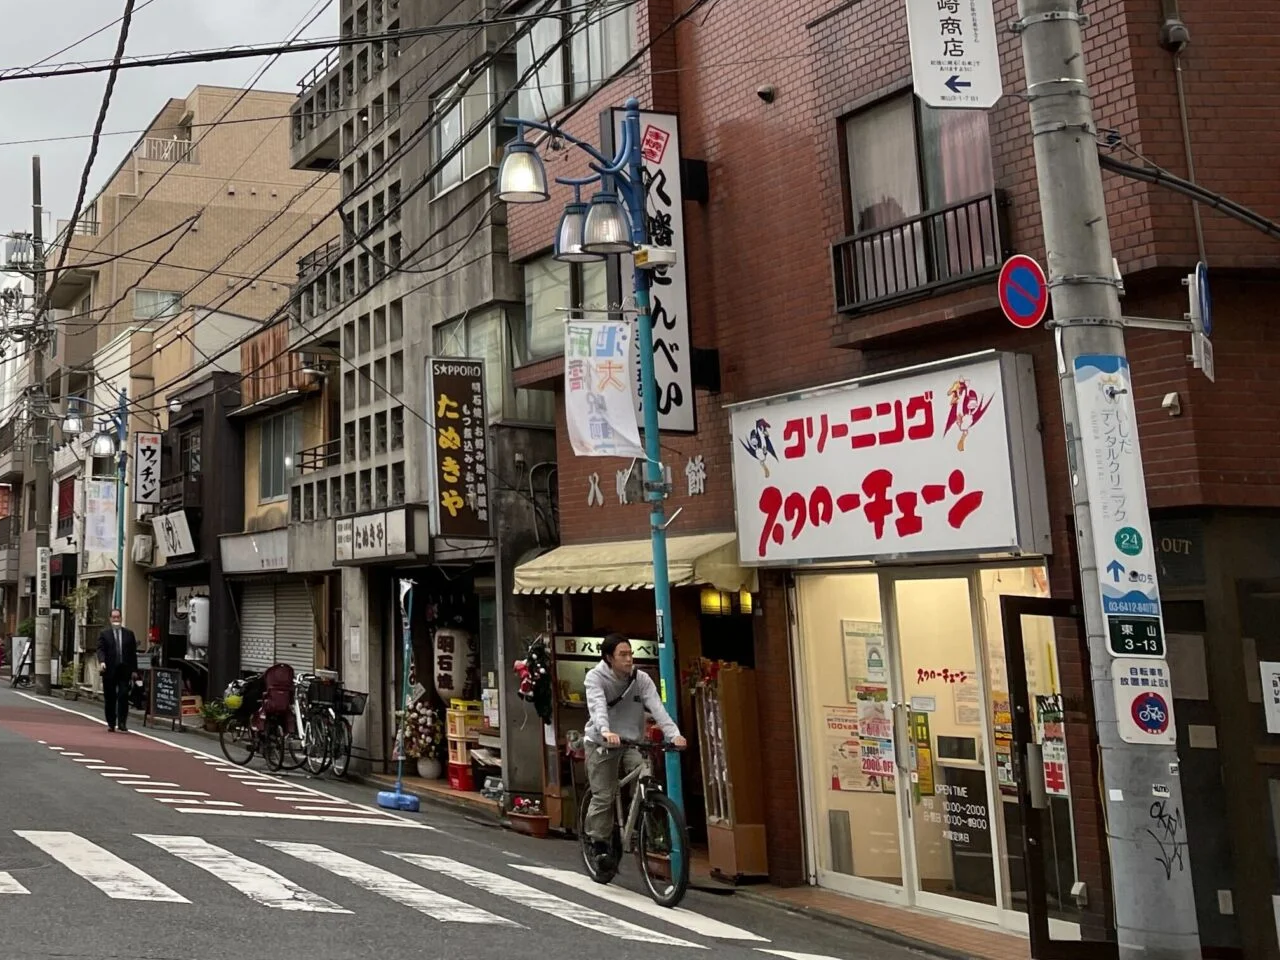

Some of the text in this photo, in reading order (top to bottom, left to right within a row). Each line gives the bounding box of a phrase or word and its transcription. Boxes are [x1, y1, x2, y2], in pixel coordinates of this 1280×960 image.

[784, 391, 935, 459] クリーニング
[140, 445, 159, 499] ウッチャン
[437, 393, 464, 517] たぬきや
[355, 520, 384, 550] たぬきや
[1124, 639, 1157, 651] 3-13
